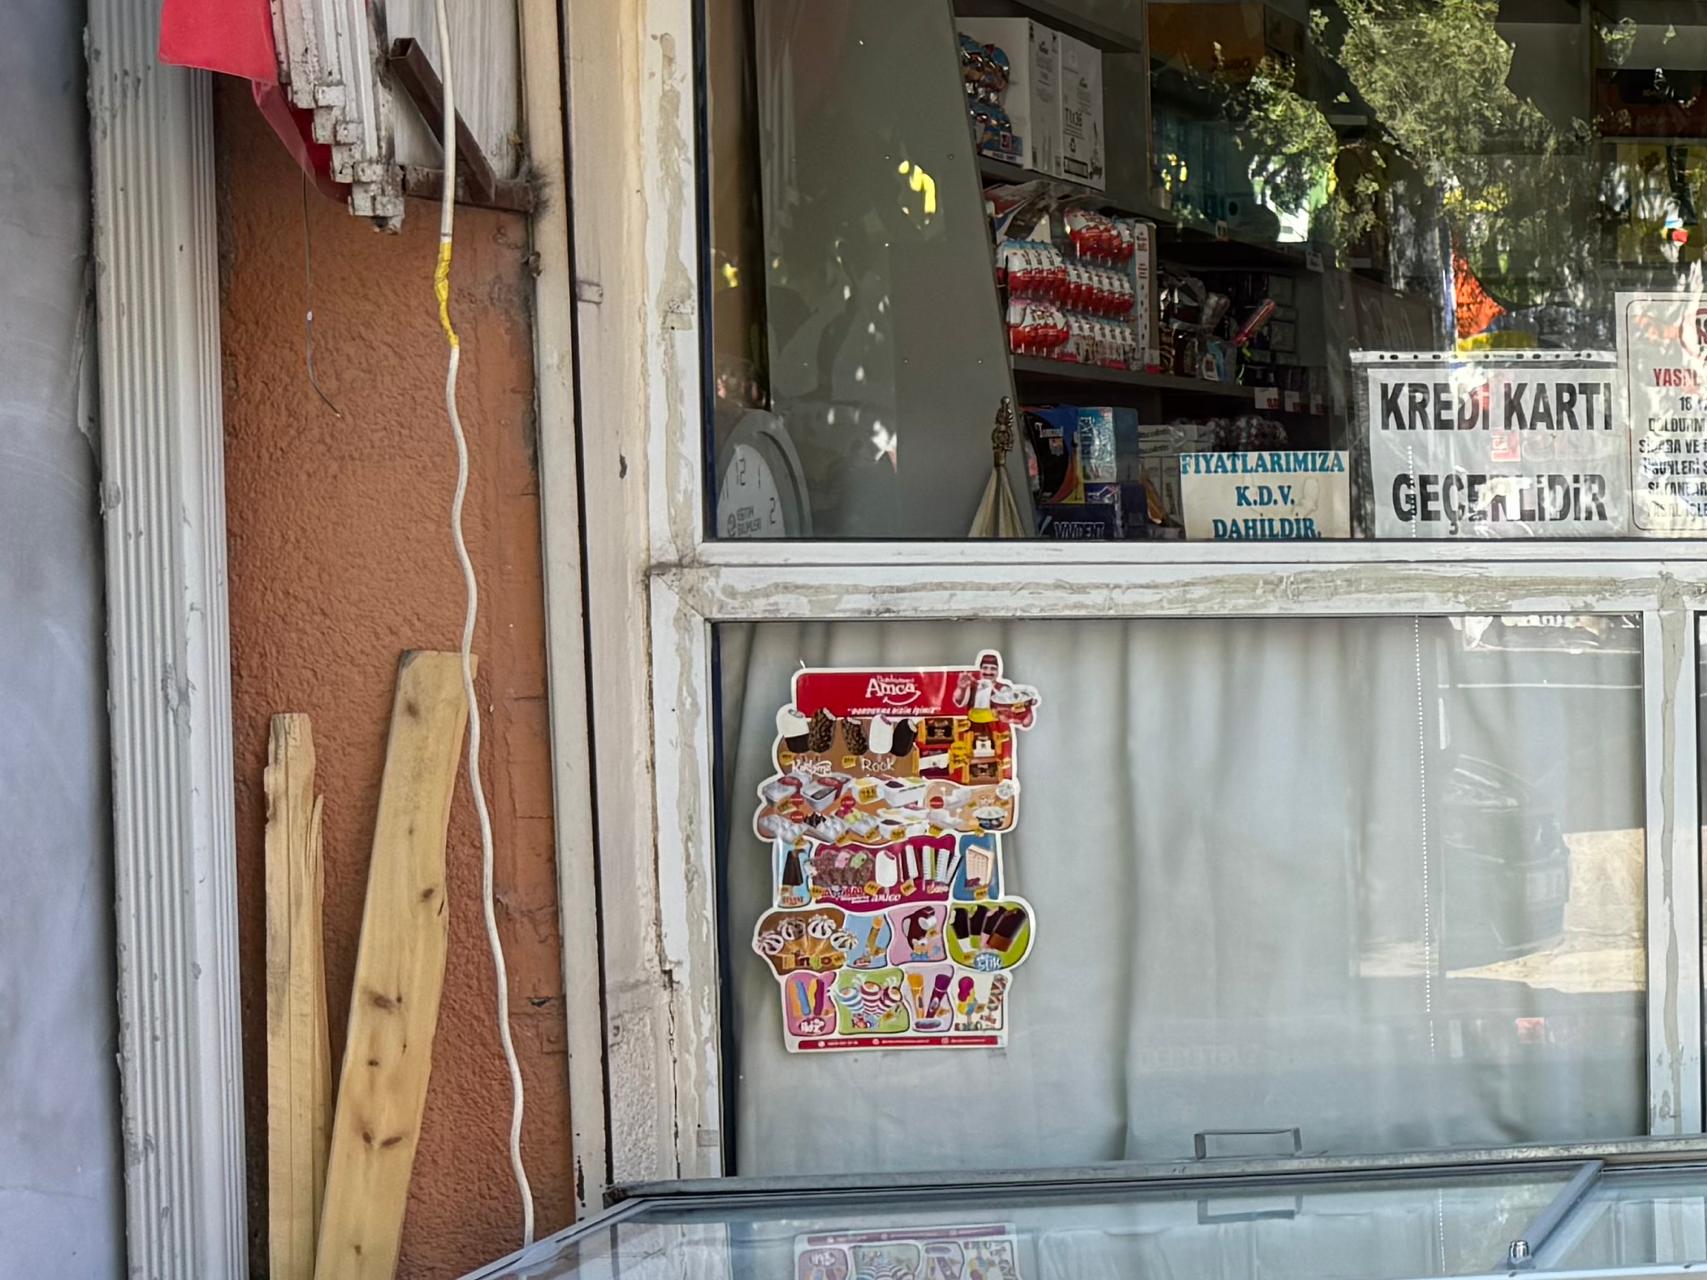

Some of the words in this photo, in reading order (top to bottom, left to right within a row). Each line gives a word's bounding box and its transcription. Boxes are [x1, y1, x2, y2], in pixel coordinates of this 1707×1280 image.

[1503, 382, 1613, 431] KARTI
[1685, 439, 1699, 453] VE
[1236, 485, 1295, 507] K.D.V.
[1213, 513, 1321, 539] DAHİLDİR.
[865, 678, 917, 699] Amca
[861, 757, 895, 772] Rock
